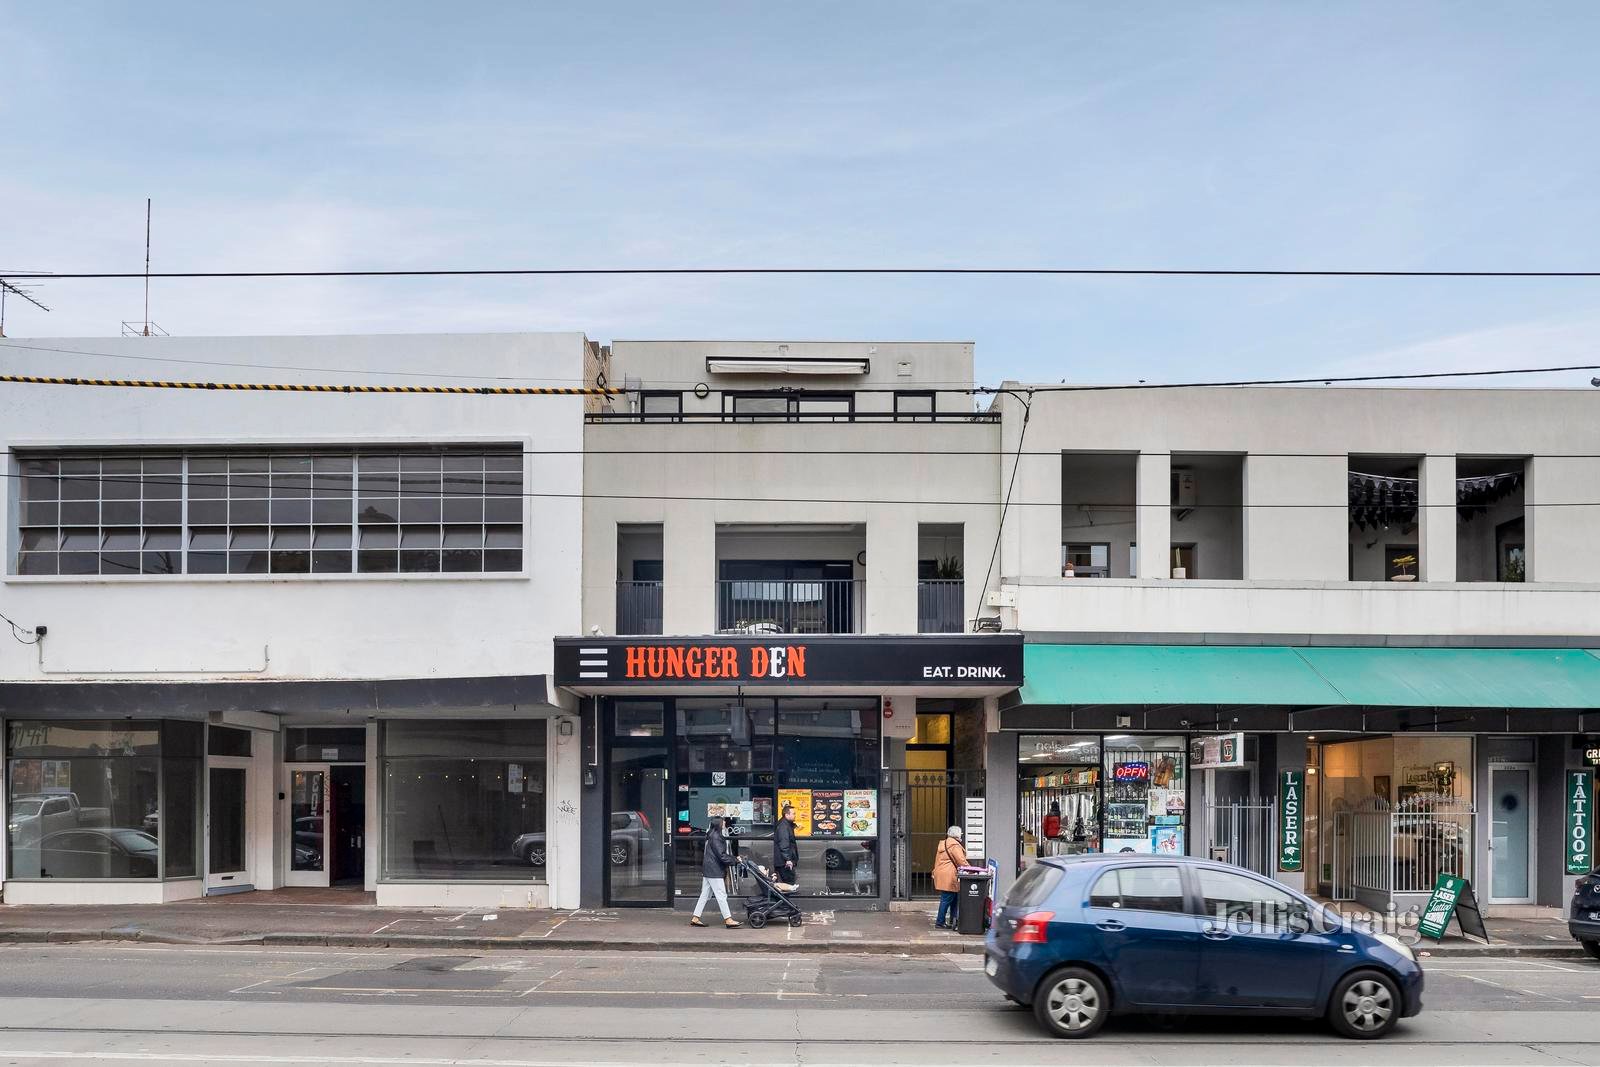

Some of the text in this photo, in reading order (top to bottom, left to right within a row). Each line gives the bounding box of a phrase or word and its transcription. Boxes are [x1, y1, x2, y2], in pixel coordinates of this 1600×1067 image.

[625, 646, 807, 678] HUNGER DEN
[923, 666, 1006, 678] EAT. DRINK.
[1285, 771, 1298, 845] LASER
[1572, 773, 1587, 853] TATTOO
[1434, 889, 1456, 902] LASER
